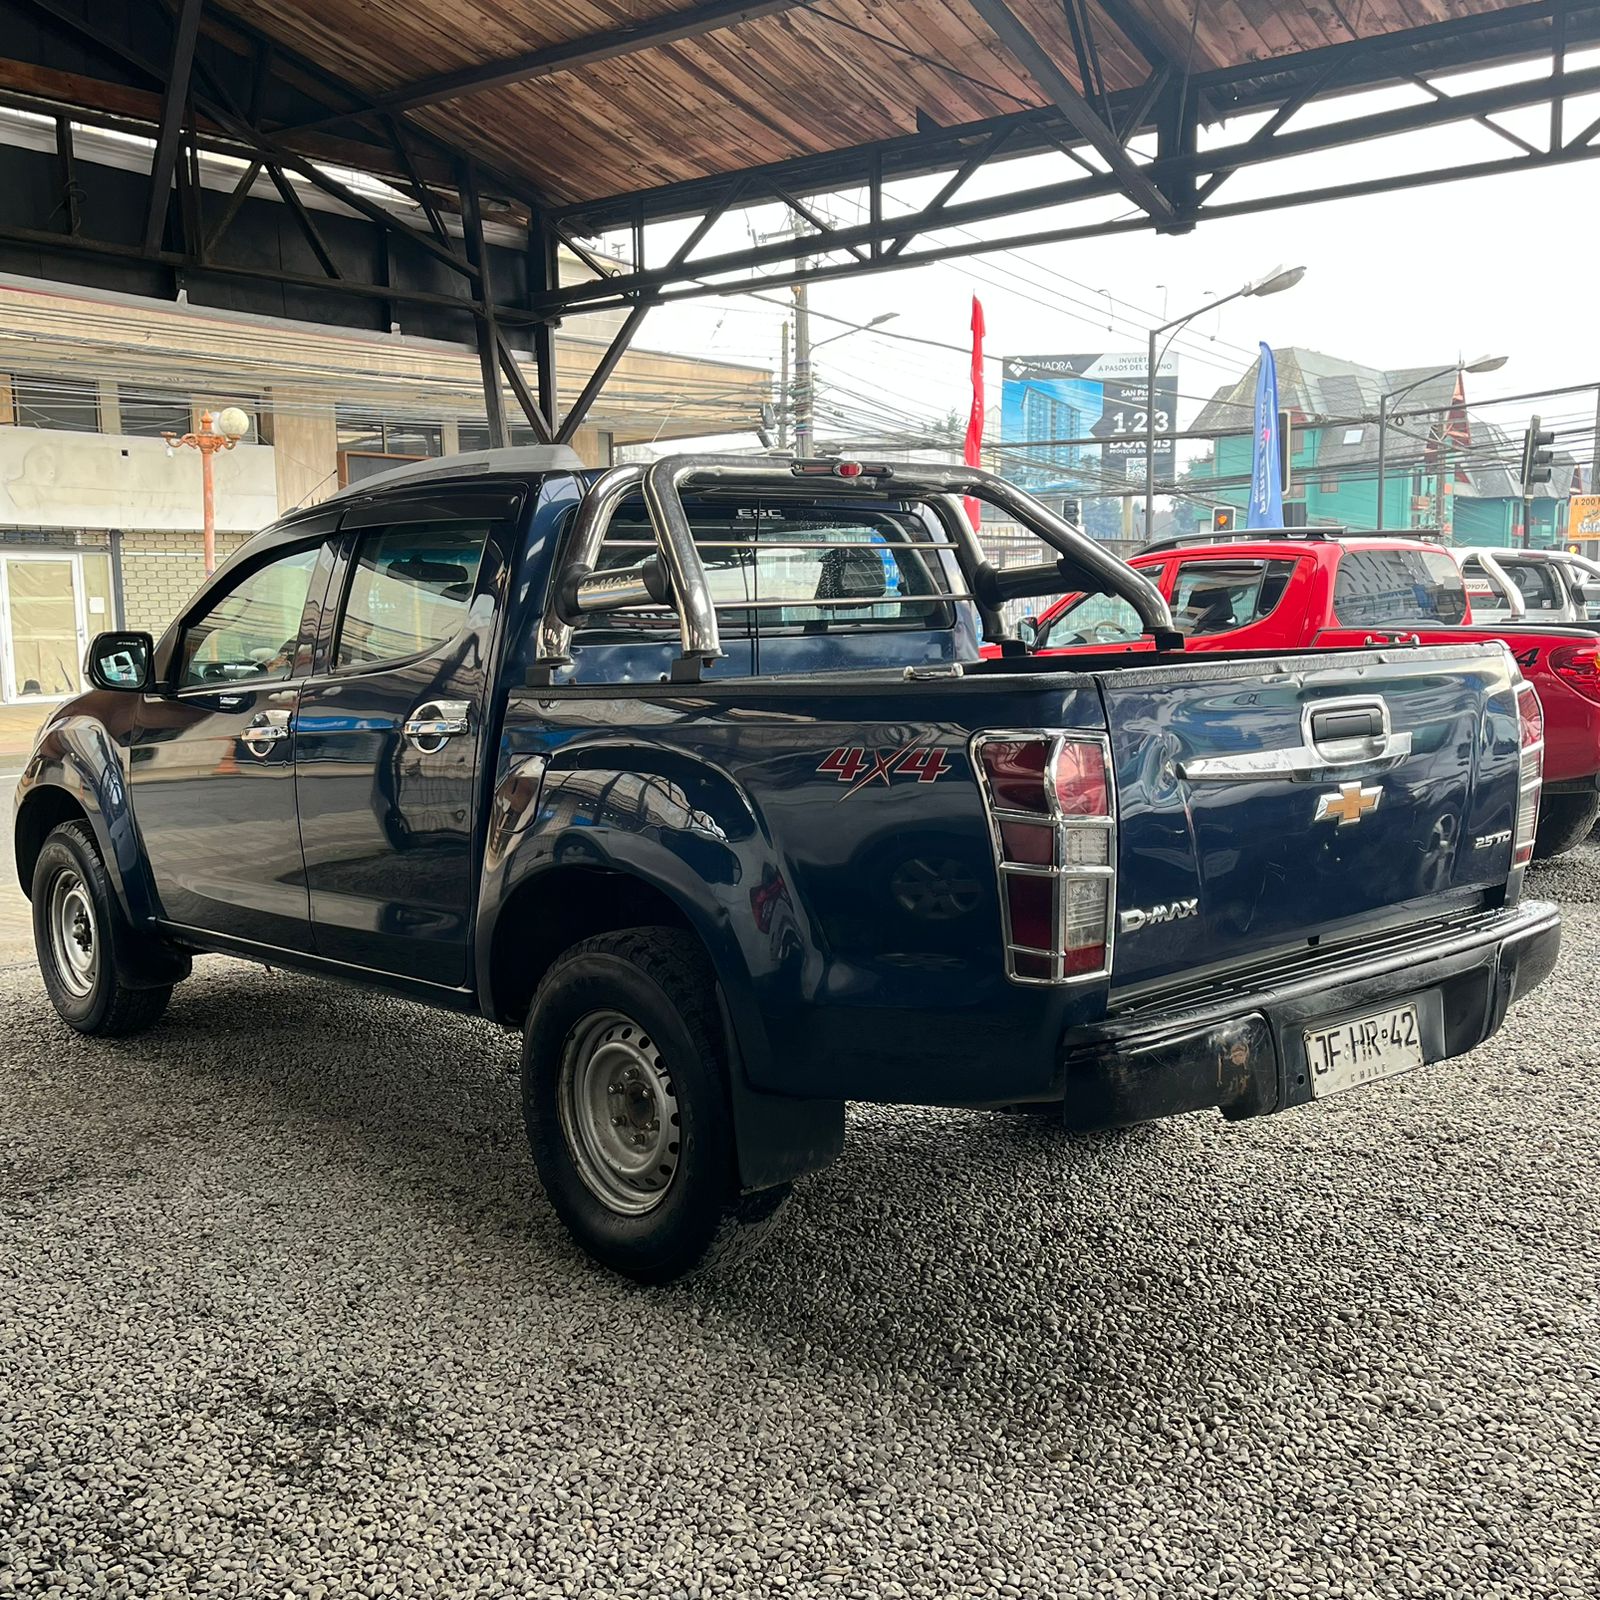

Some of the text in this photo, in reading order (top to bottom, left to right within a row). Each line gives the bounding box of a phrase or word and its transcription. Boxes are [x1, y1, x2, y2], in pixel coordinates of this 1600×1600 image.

[1119, 356, 1148, 364] INVIERT
[1105, 364, 1128, 372] PASOS
[1129, 363, 1143, 371] DEL
[1581, 498, 1596, 506] 200
[1120, 898, 1199, 934] D-MAX
[1350, 1063, 1388, 1082] CHILE
